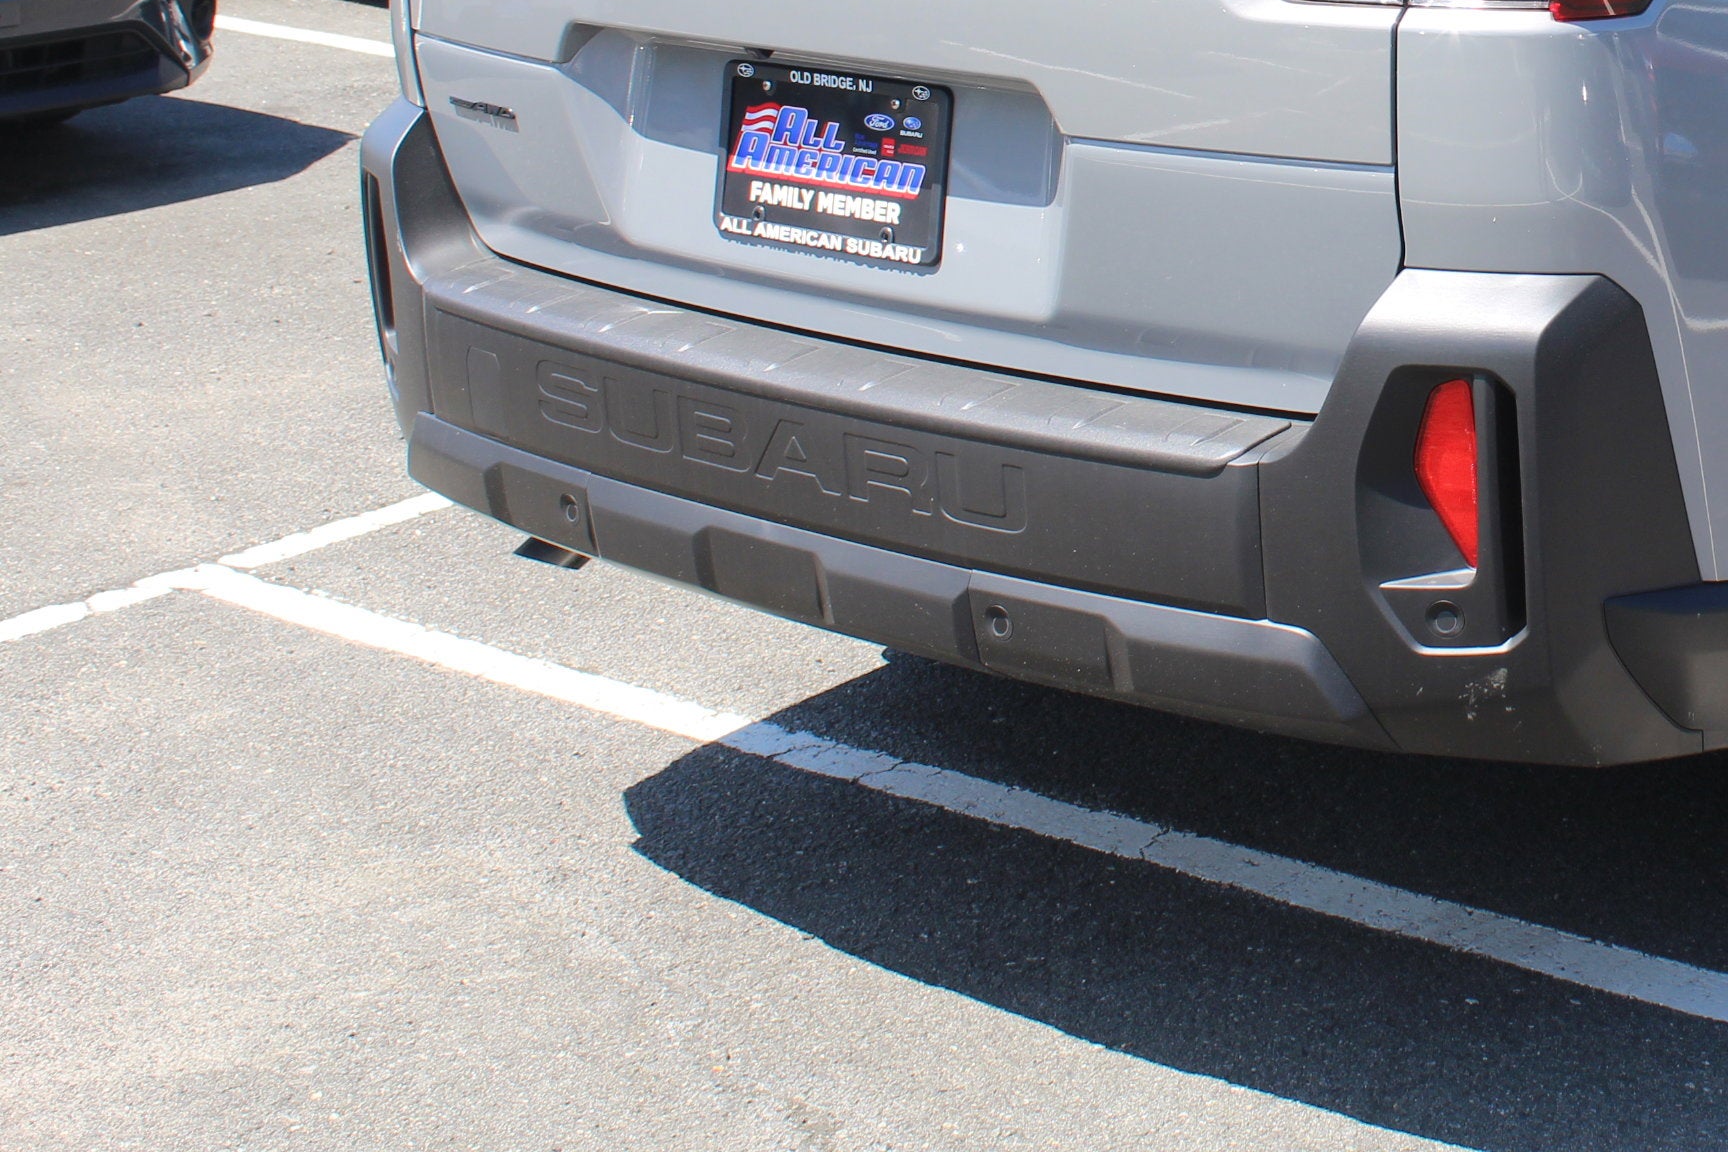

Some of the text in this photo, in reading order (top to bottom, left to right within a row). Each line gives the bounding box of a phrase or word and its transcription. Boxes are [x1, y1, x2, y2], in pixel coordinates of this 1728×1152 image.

[789, 70, 873, 93] OLD BRIDGE, NJ
[749, 180, 901, 225] FAMILY MEMBER
[719, 215, 922, 265] ALL AMERICAN SUBARU
[535, 359, 1029, 534] SUBARU
